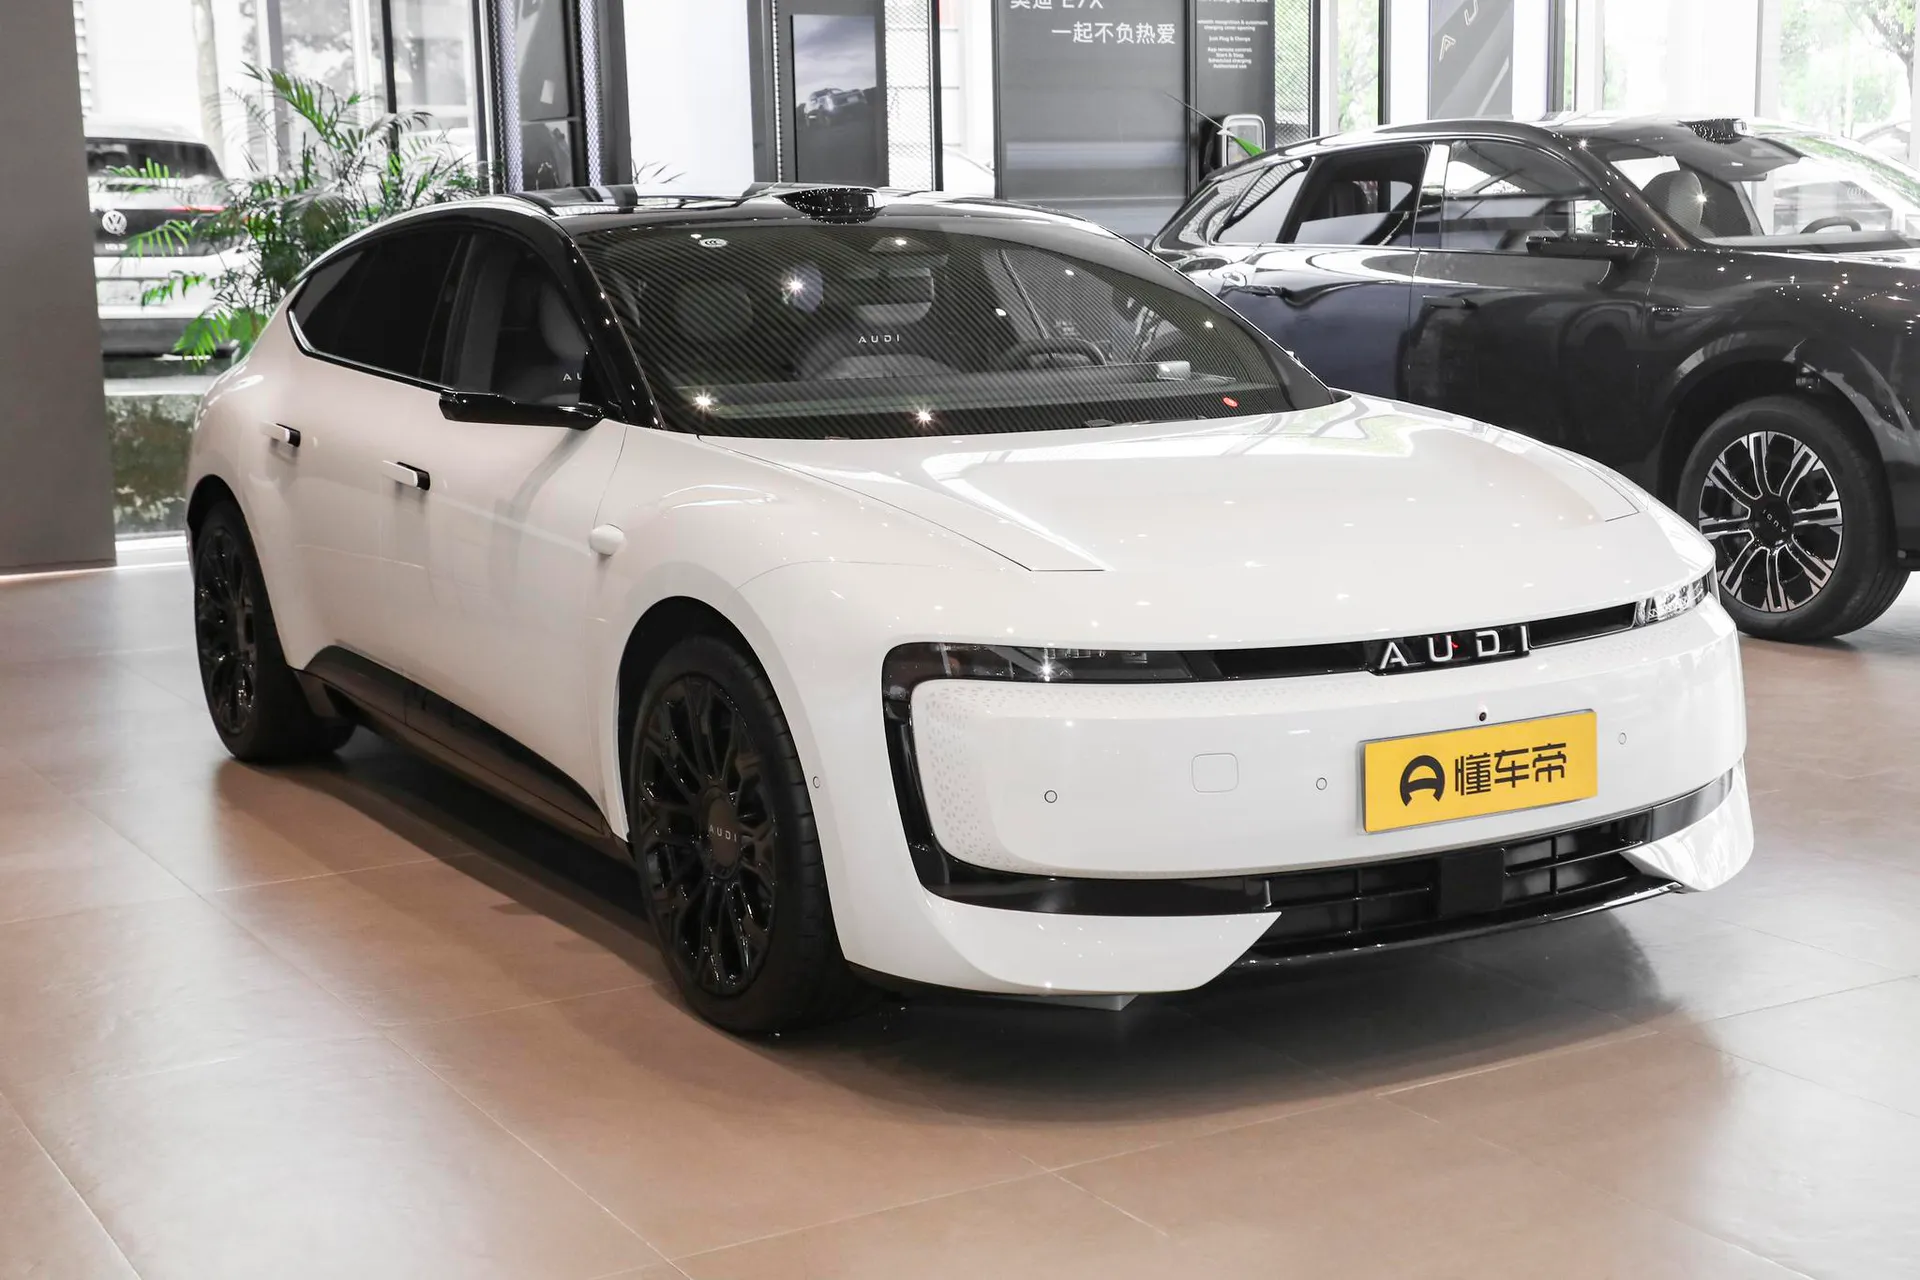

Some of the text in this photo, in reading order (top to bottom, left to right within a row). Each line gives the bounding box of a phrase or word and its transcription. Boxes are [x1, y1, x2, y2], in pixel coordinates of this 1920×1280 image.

[1052, 21, 1176, 45] 一起不负热爱
[858, 333, 900, 344] AUDI
[1379, 625, 1531, 670] AUDI
[1454, 742, 1567, 796] 懂车帝
[709, 824, 738, 843] AUDI
